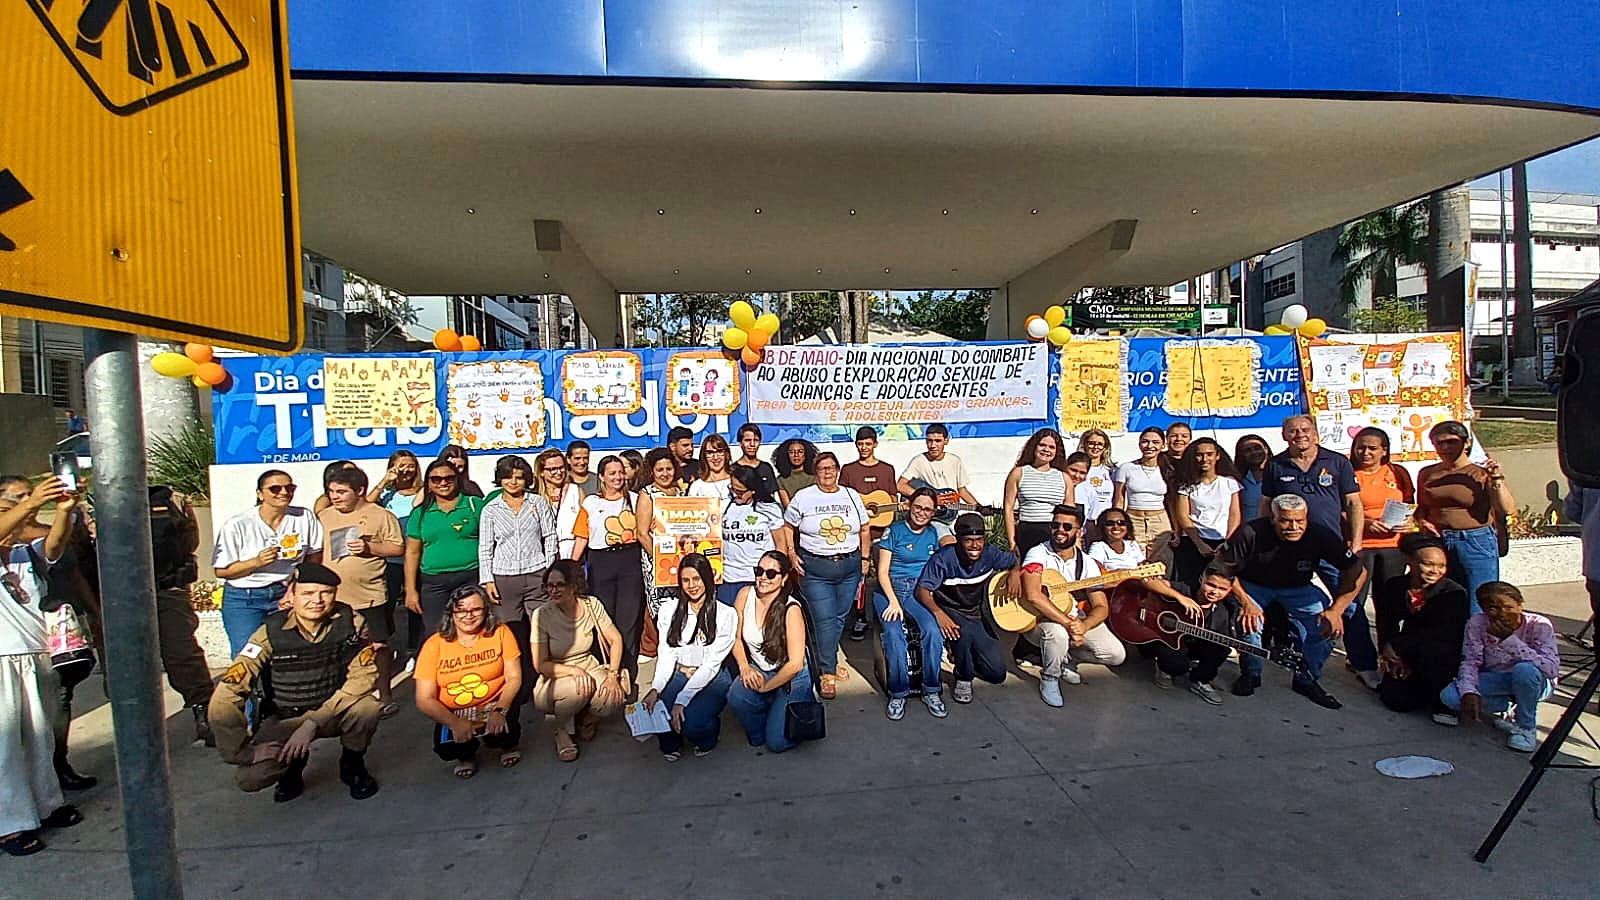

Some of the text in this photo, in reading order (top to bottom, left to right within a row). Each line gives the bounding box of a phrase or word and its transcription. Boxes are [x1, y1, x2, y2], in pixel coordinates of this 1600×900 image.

[1089, 305, 1115, 314] CMO
[778, 350, 797, 366] DE
[846, 350, 867, 365] DIA
[870, 350, 946, 366] NACIONAL
[952, 349, 969, 365] DO
[973, 346, 1037, 364] COMBATE
[326, 360, 434, 381] MAIO LARANJA
[757, 363, 1024, 383] AO ABUSO E EXPLORAÇÃO SEXUAL DE
[255, 368, 325, 392] Dia d
[781, 382, 989, 401] CRIANÇAS E ADOLESCENTES
[911, 399, 960, 410] NOSSAS
[830, 412, 837, 421] E
[274, 453, 290, 463] DE
[292, 453, 321, 463] MAIO
[669, 510, 708, 519] MAIO
[464, 649, 496, 665] BONITO
